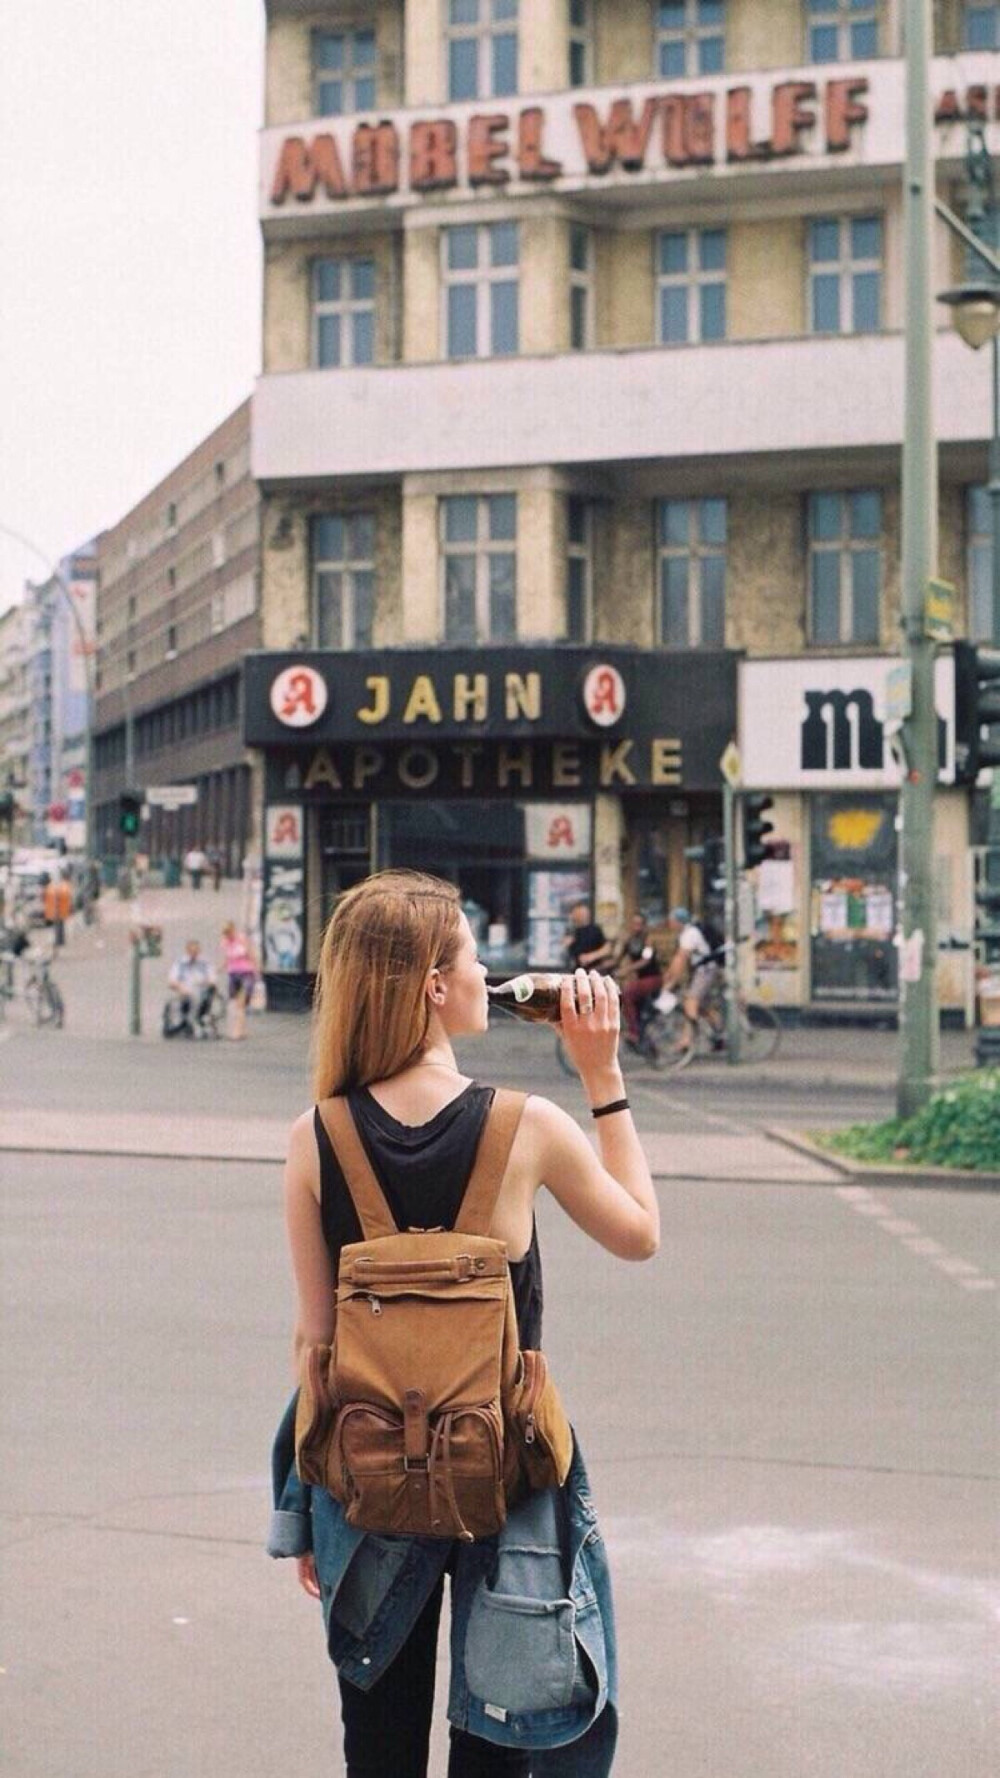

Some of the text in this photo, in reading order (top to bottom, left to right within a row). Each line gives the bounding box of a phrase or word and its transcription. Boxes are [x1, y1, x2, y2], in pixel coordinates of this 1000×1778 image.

[271, 107, 562, 205] MÖBEL
[357, 671, 542, 725] JAHN
[303, 738, 683, 790] APOTHEKE
